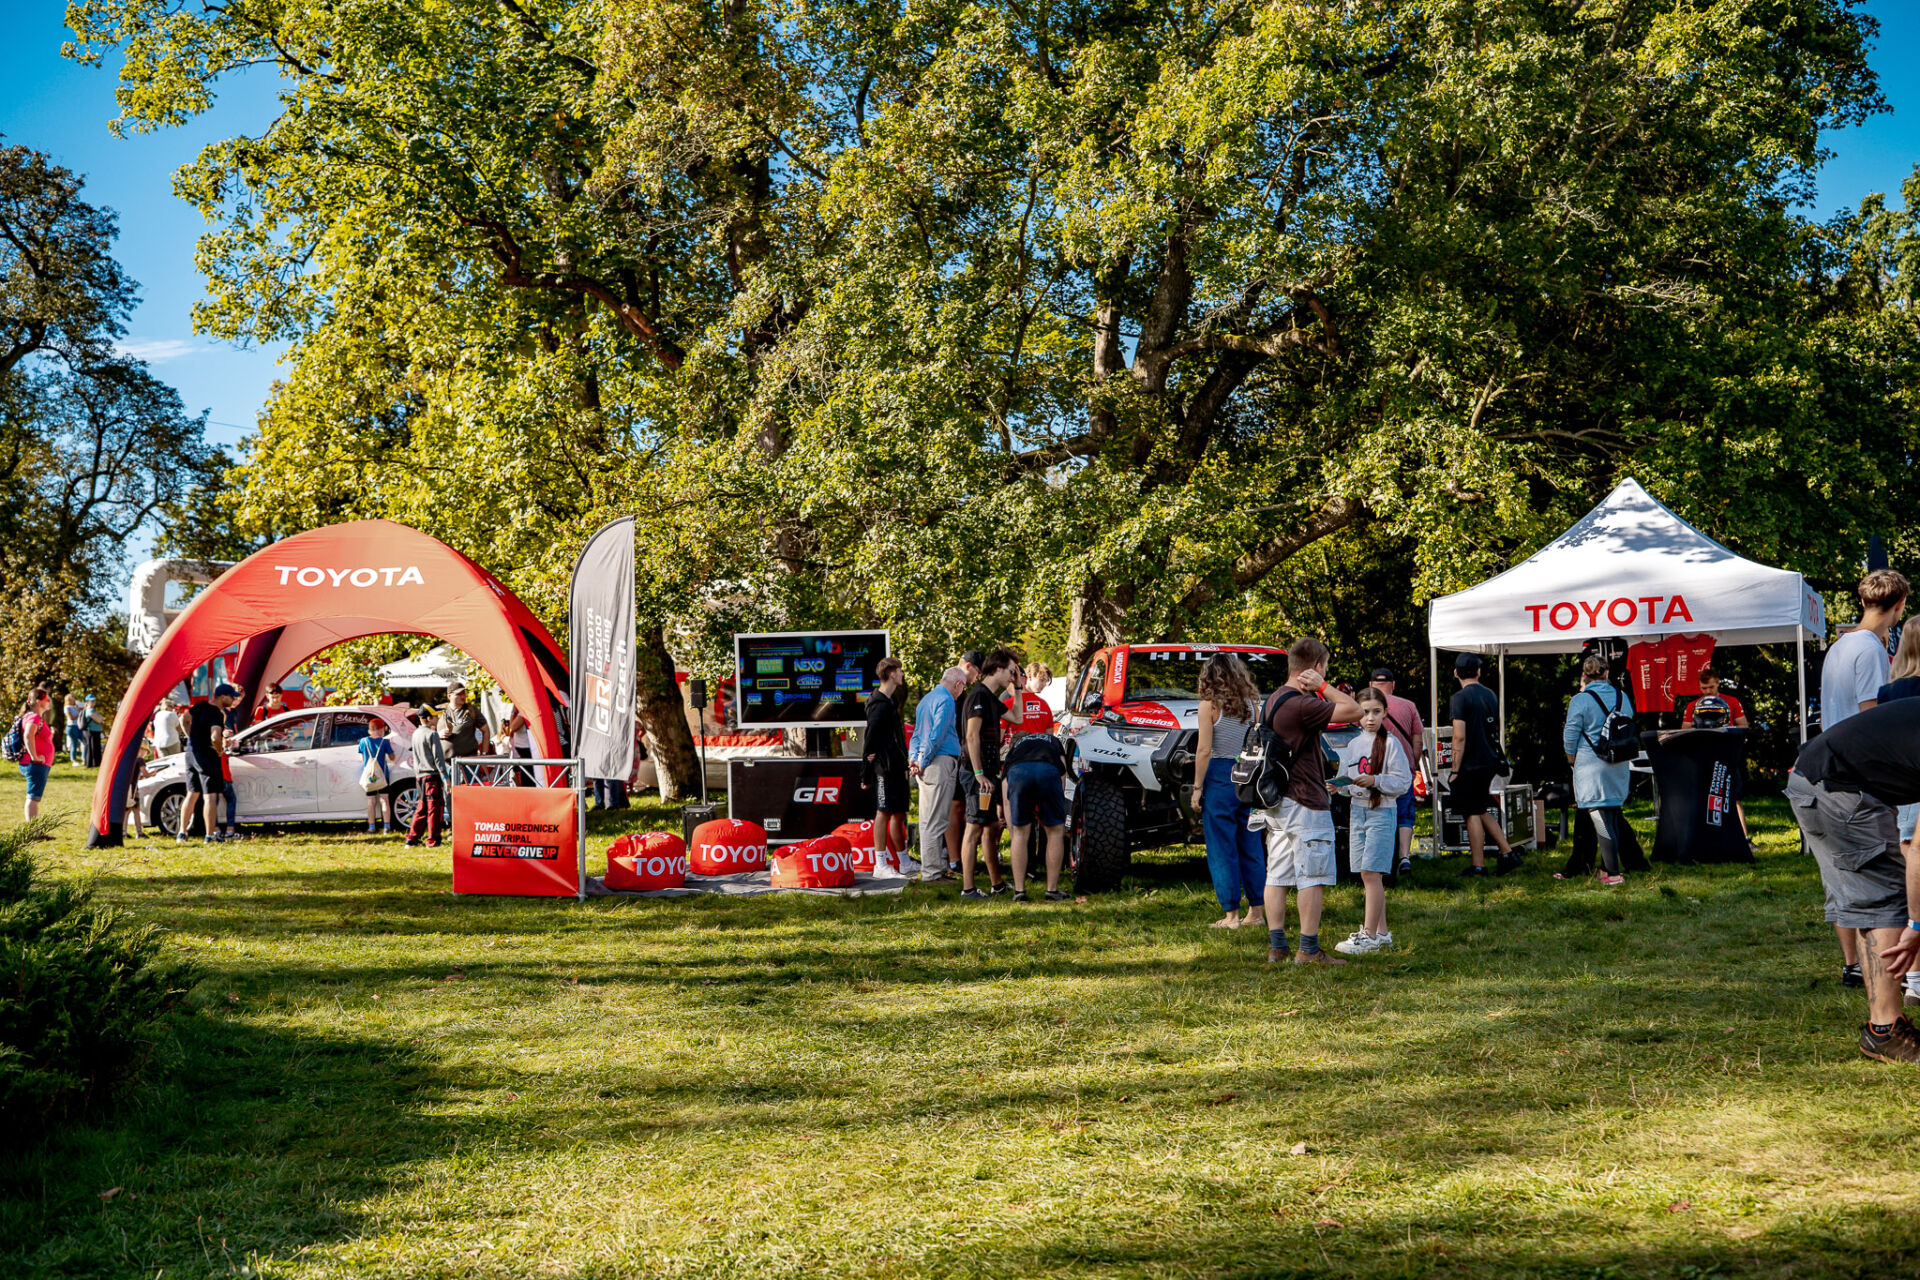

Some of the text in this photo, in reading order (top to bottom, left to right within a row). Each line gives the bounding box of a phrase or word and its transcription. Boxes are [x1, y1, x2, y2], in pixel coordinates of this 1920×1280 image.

[275, 565, 425, 588] TOYOTA
[1524, 594, 1694, 632] TOYOTA
[595, 615, 603, 673] GAZOO
[794, 658, 825, 672] NEXO
[1150, 651, 1268, 661] HILX
[616, 640, 627, 713] Czech
[595, 679, 611, 733] GR
[1131, 716, 1175, 727] agados
[793, 787, 839, 802] GR
[1712, 798, 1722, 824] GR
[473, 845, 557, 858] #NEVERGIVEUP
[700, 844, 767, 863] TOYOT
